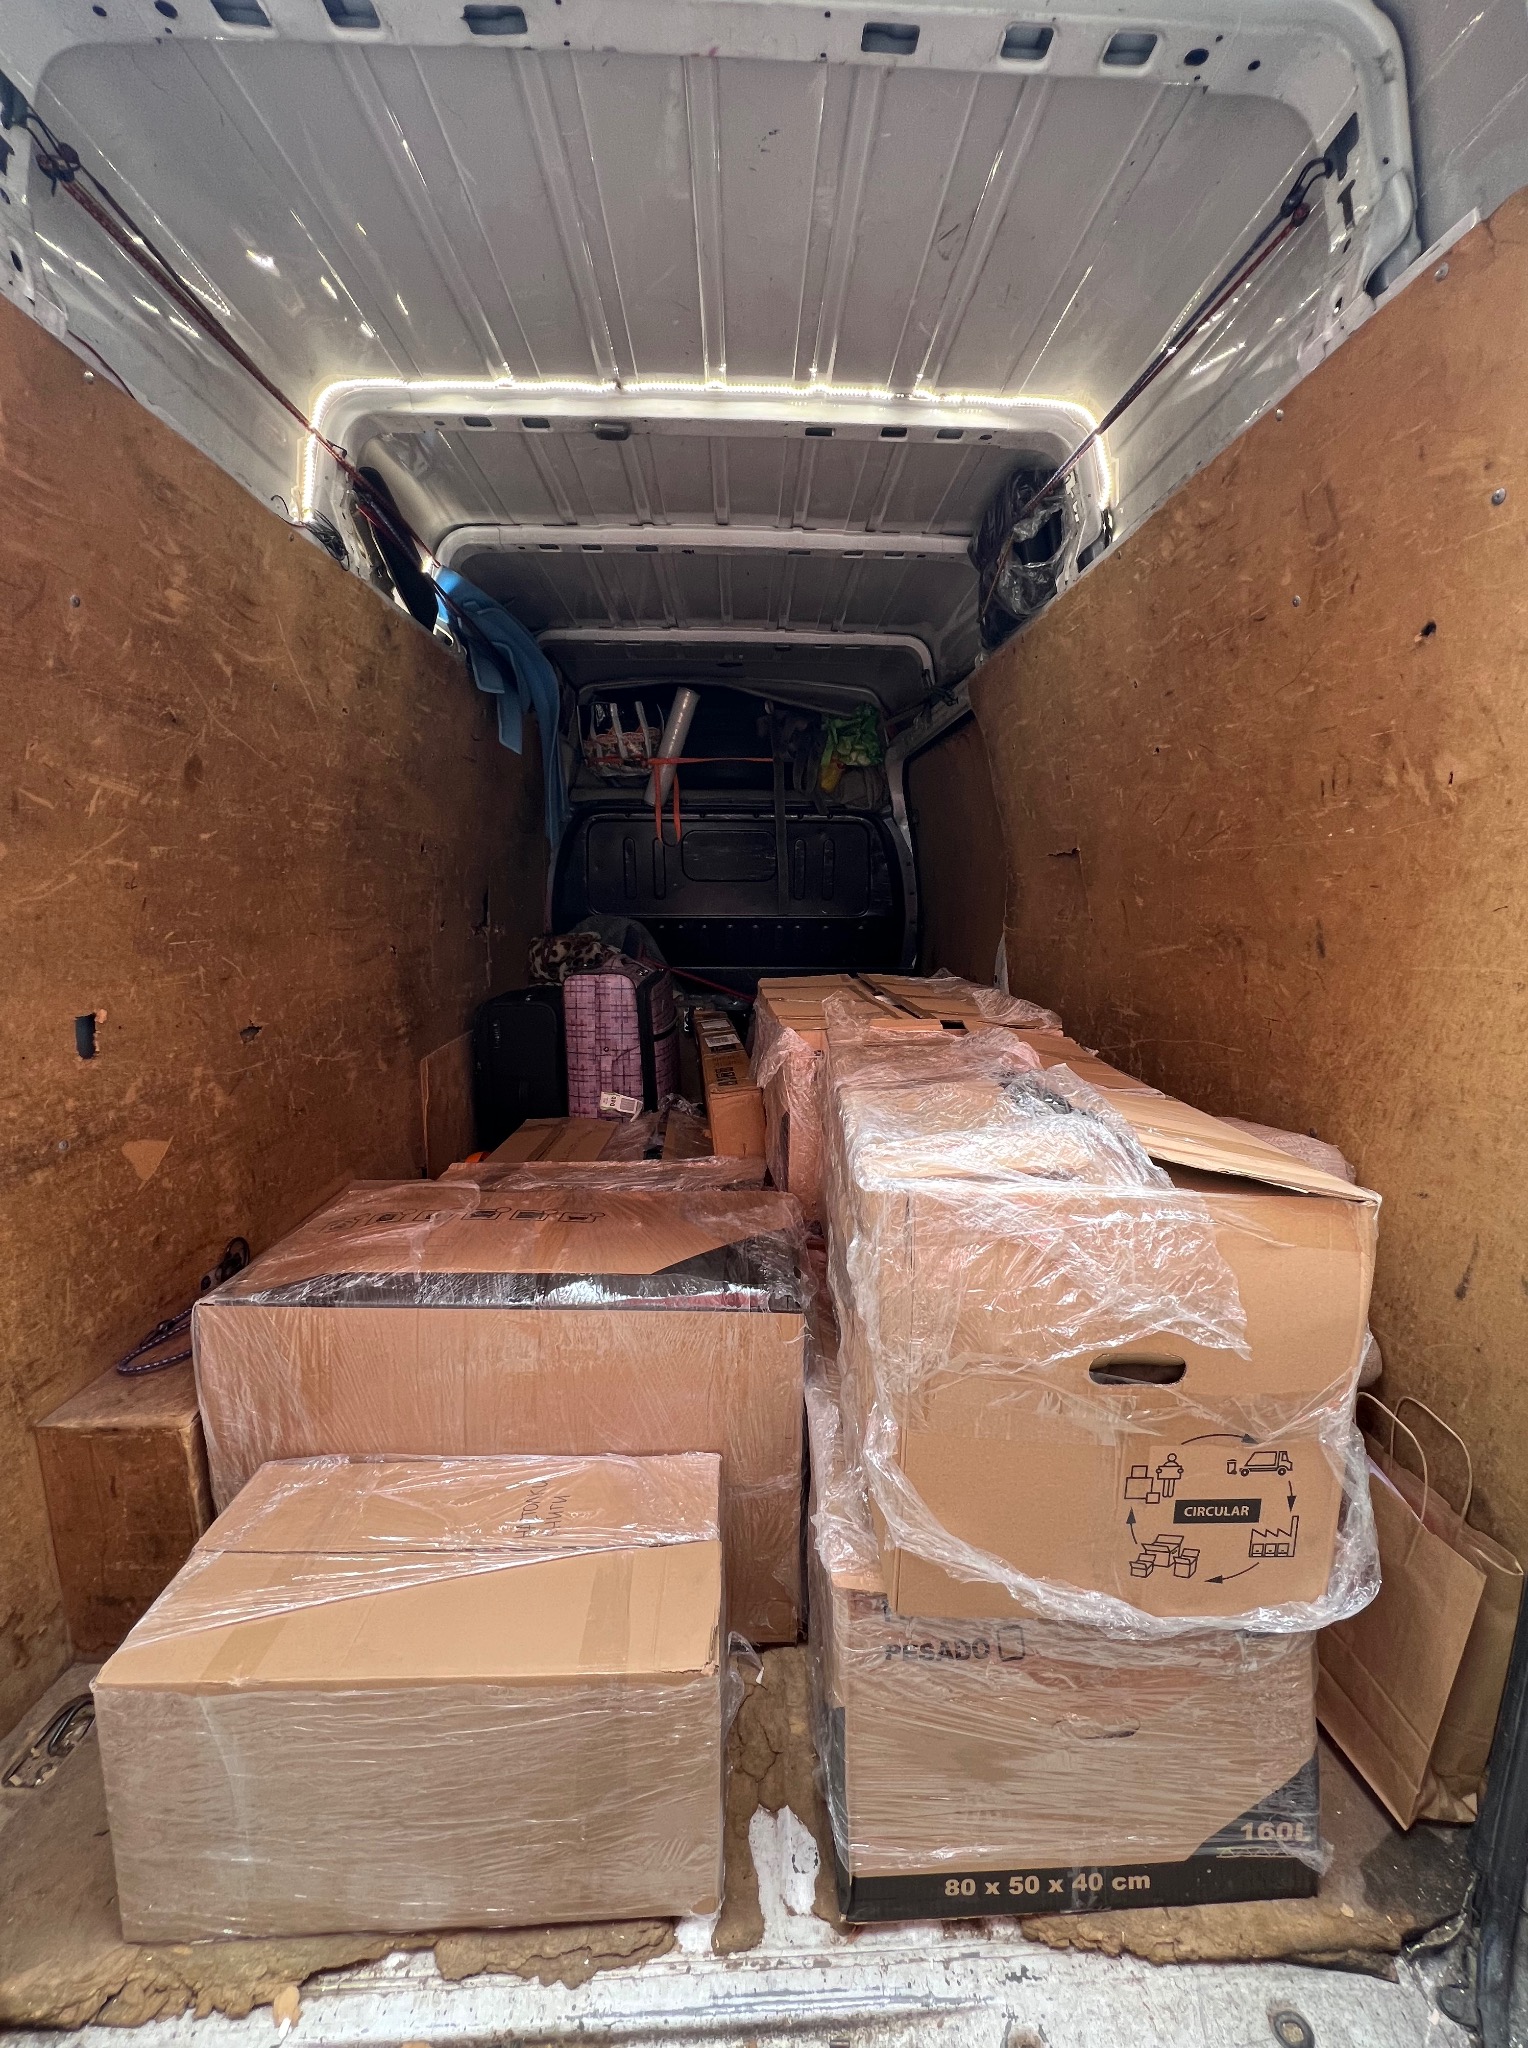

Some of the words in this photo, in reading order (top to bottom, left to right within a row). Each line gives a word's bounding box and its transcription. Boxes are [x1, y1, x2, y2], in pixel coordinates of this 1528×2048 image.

[513, 1479, 548, 1539] НАТОЛКИ
[1183, 1505, 1250, 1517] CIRCULAR
[885, 1637, 990, 1662] PESADO
[944, 1878, 976, 1897] 80
[984, 1881, 1000, 1895] x
[1008, 1875, 1040, 1895] 50
[1048, 1878, 1064, 1893] x
[1071, 1872, 1104, 1892] 40
[1111, 1874, 1151, 1890] cm
